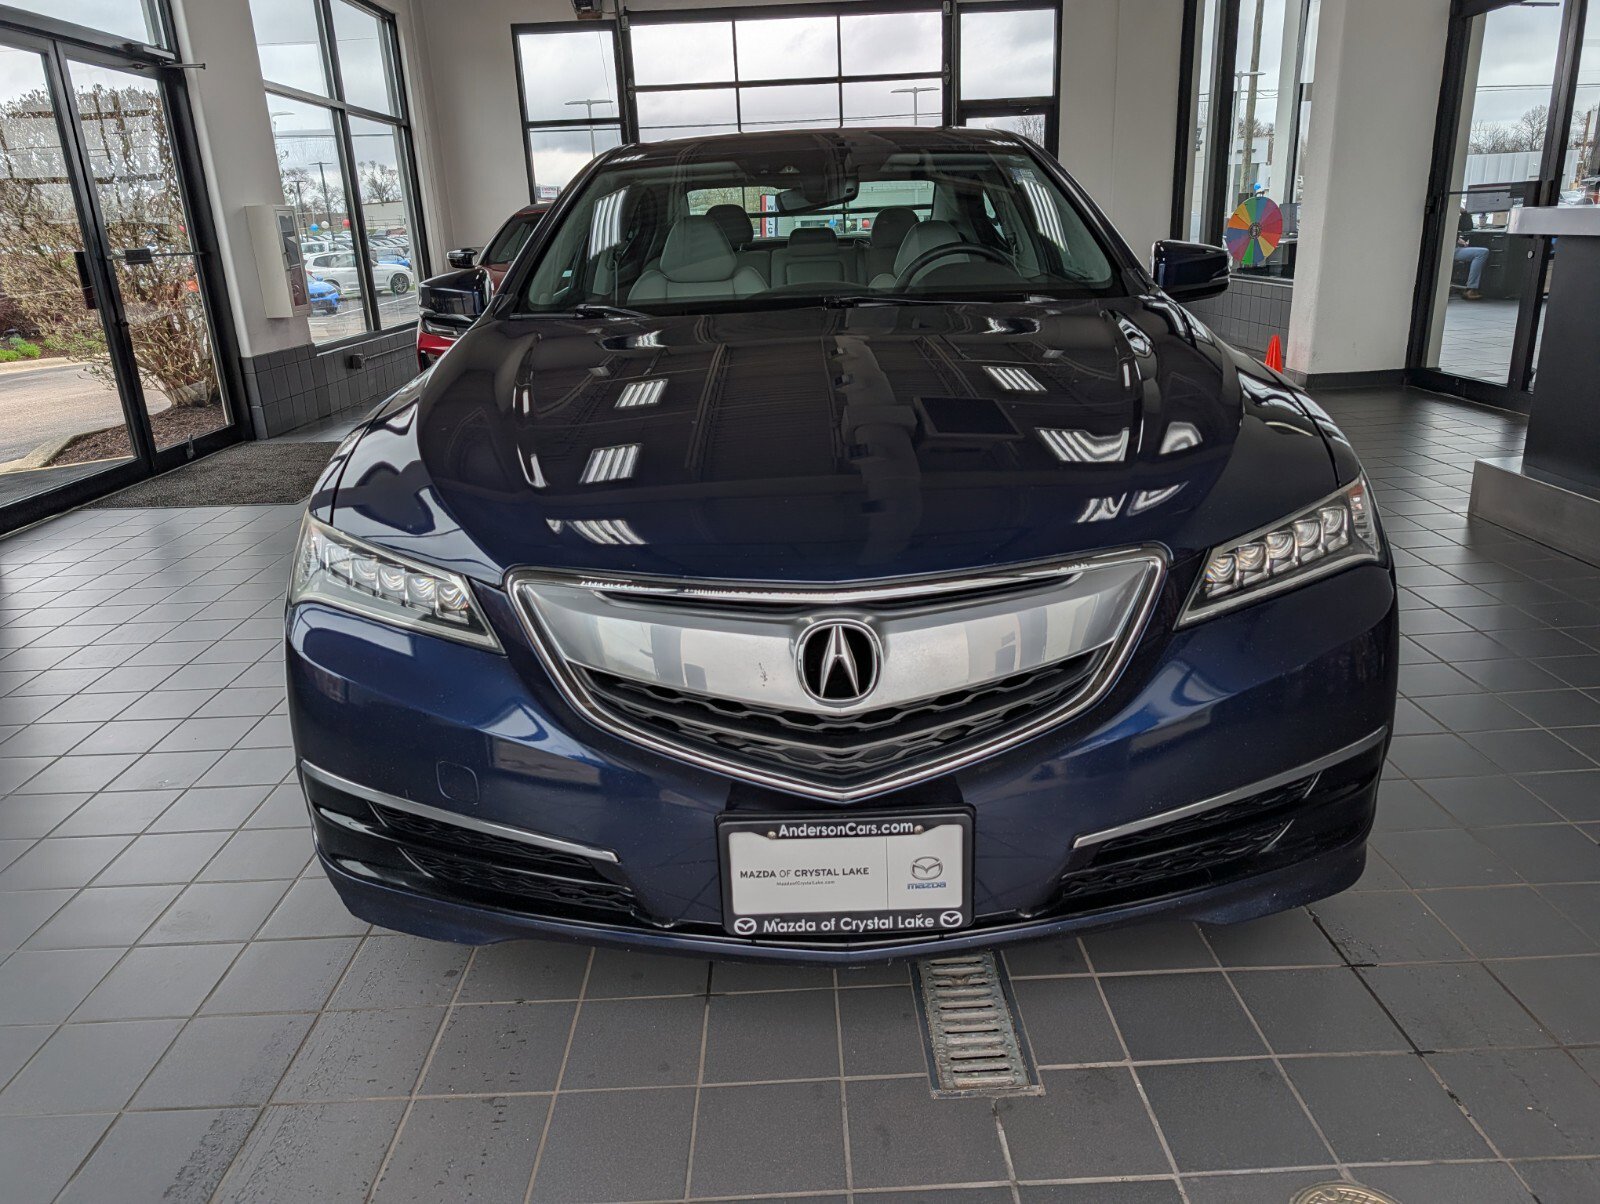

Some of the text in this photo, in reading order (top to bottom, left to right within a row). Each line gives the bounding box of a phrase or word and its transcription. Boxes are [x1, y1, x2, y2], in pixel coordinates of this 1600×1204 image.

[778, 821, 915, 838] AndersonCars.com
[740, 867, 870, 879] MAZDA OF CRYSTAL LAKE
[763, 915, 935, 934] Mazda of Crystal Lake
